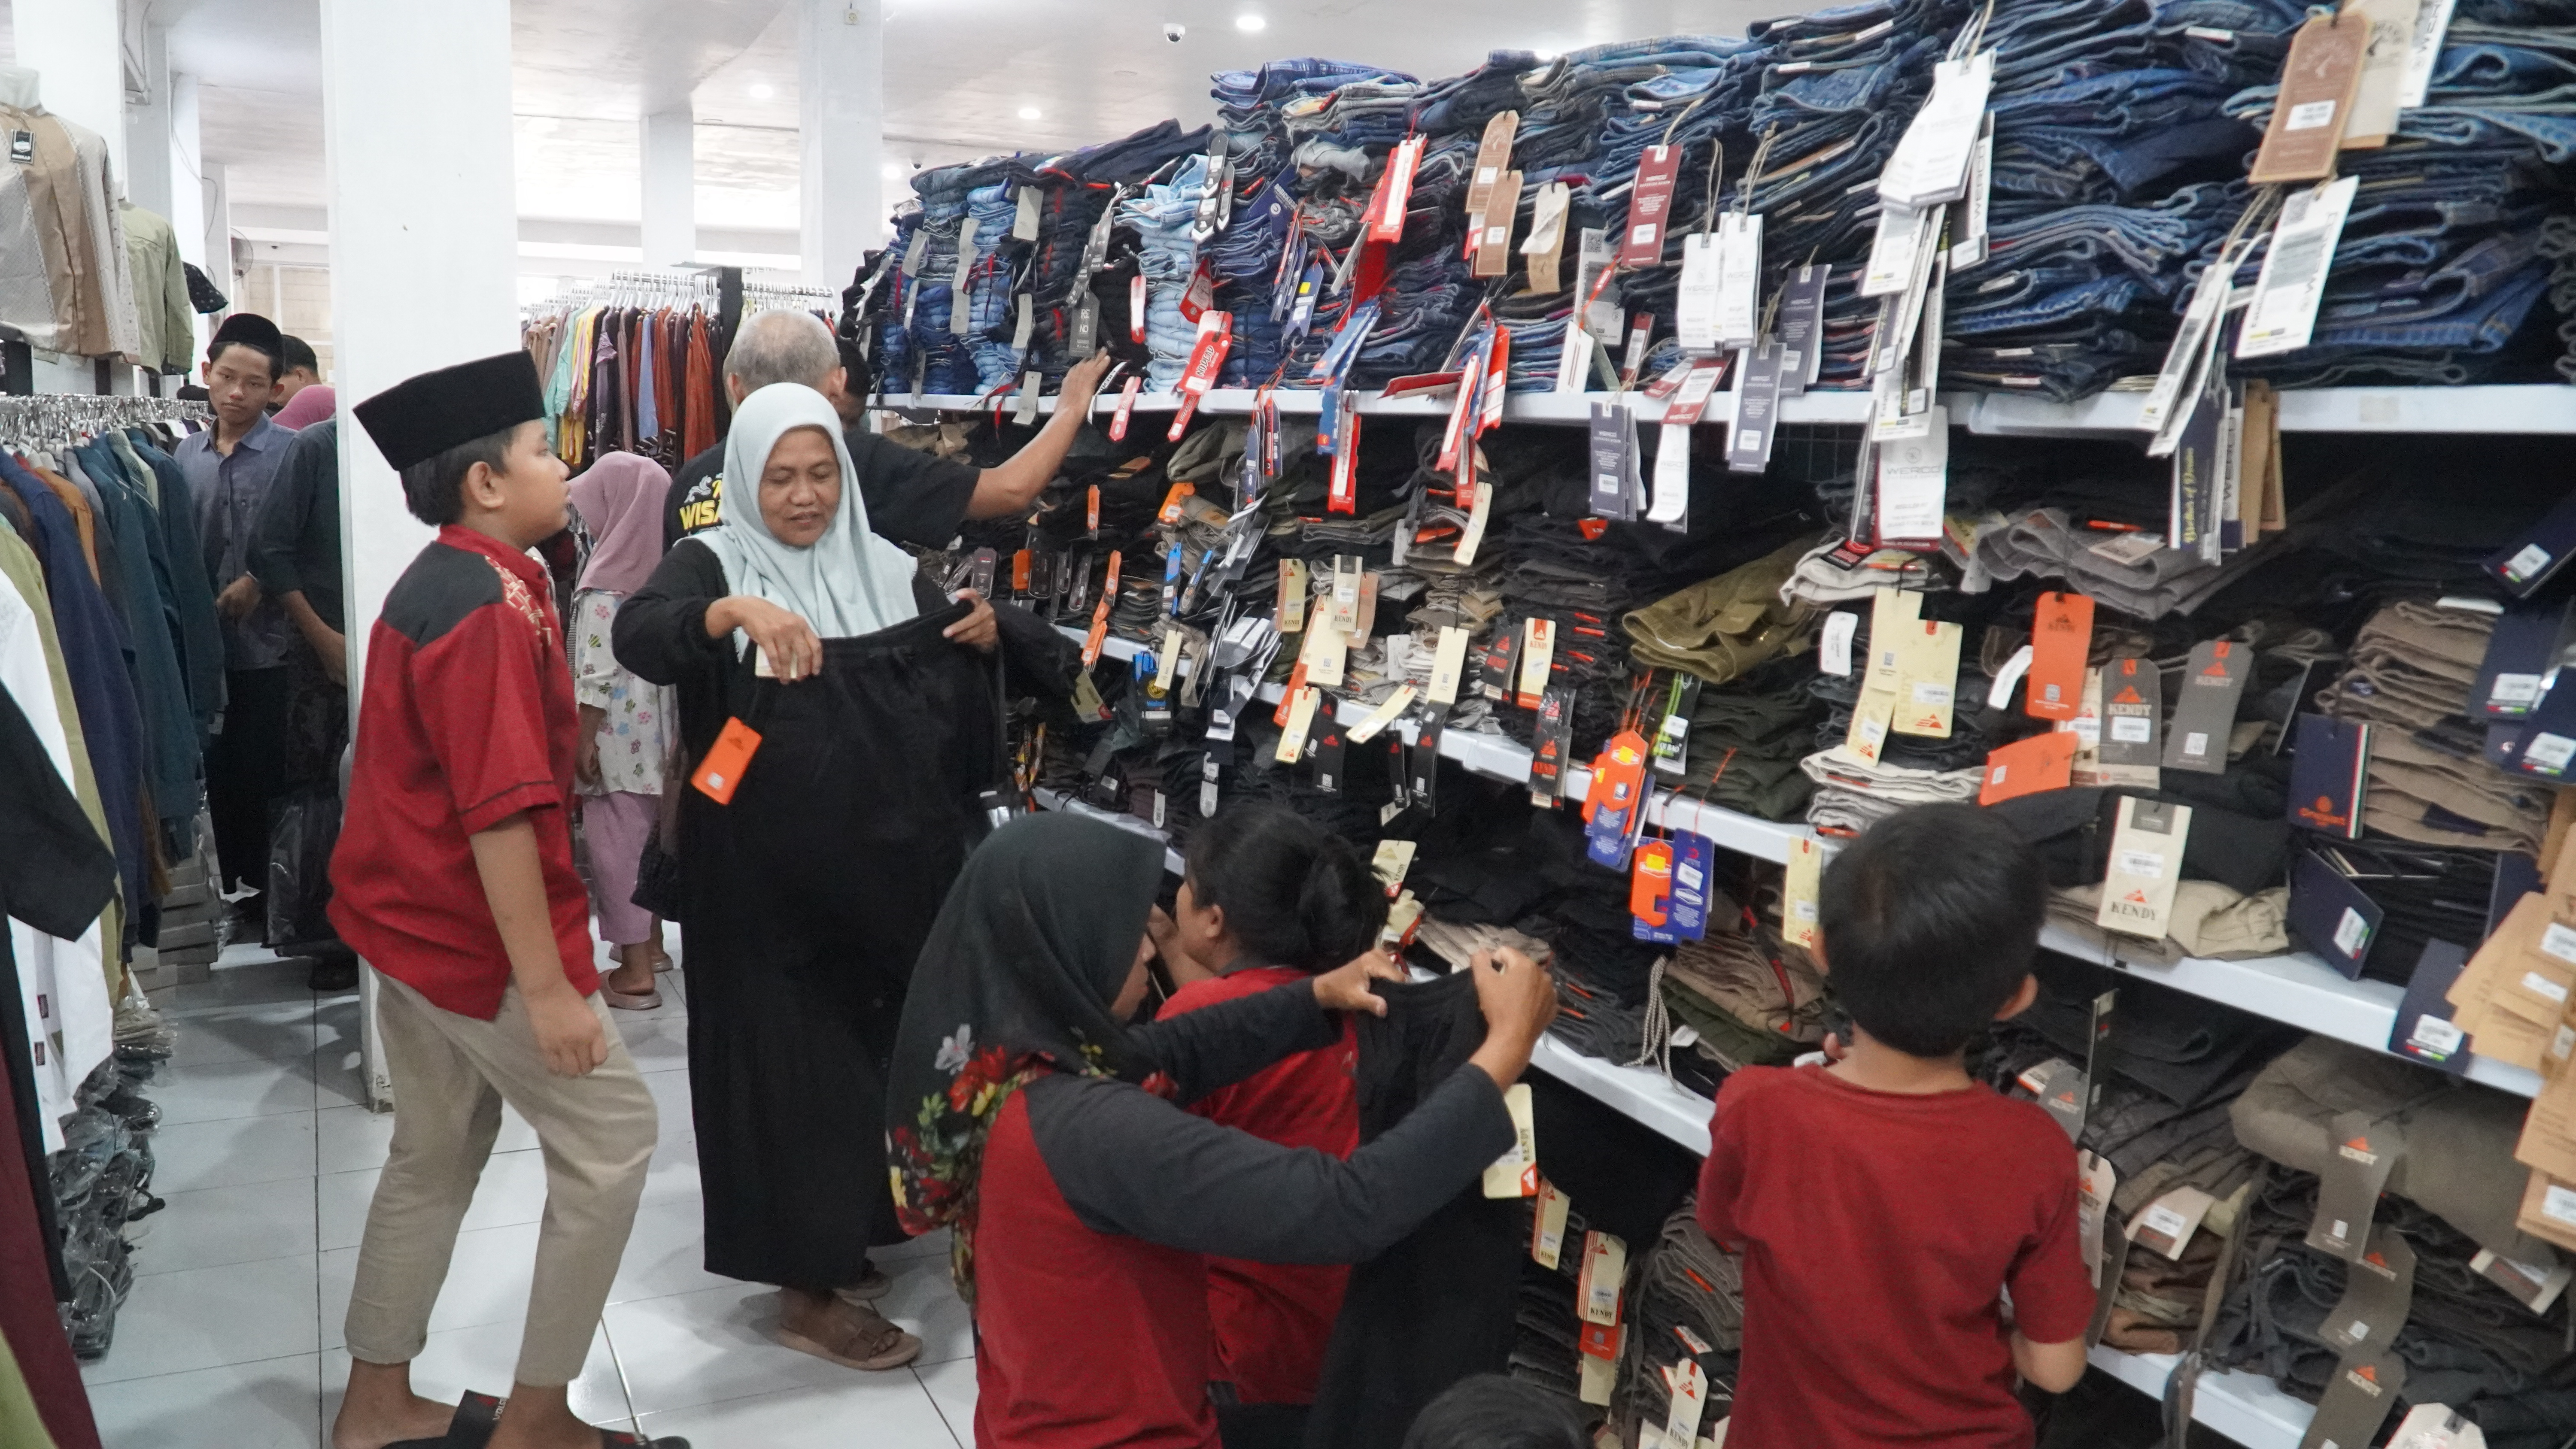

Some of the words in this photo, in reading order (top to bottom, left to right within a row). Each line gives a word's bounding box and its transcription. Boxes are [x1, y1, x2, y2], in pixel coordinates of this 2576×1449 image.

[1079, 324, 1089, 333] NO
[1196, 345, 1214, 377] NODEAD
[1887, 466, 1941, 474] WERCO
[1334, 615, 1353, 623] KENDY
[1530, 640, 1548, 650] KENDY
[2108, 703, 2152, 716] KENDY
[2111, 901, 2159, 921] KENDY
[1519, 1128, 1529, 1162] KENDY
[1590, 1307, 1613, 1319] KENDY
